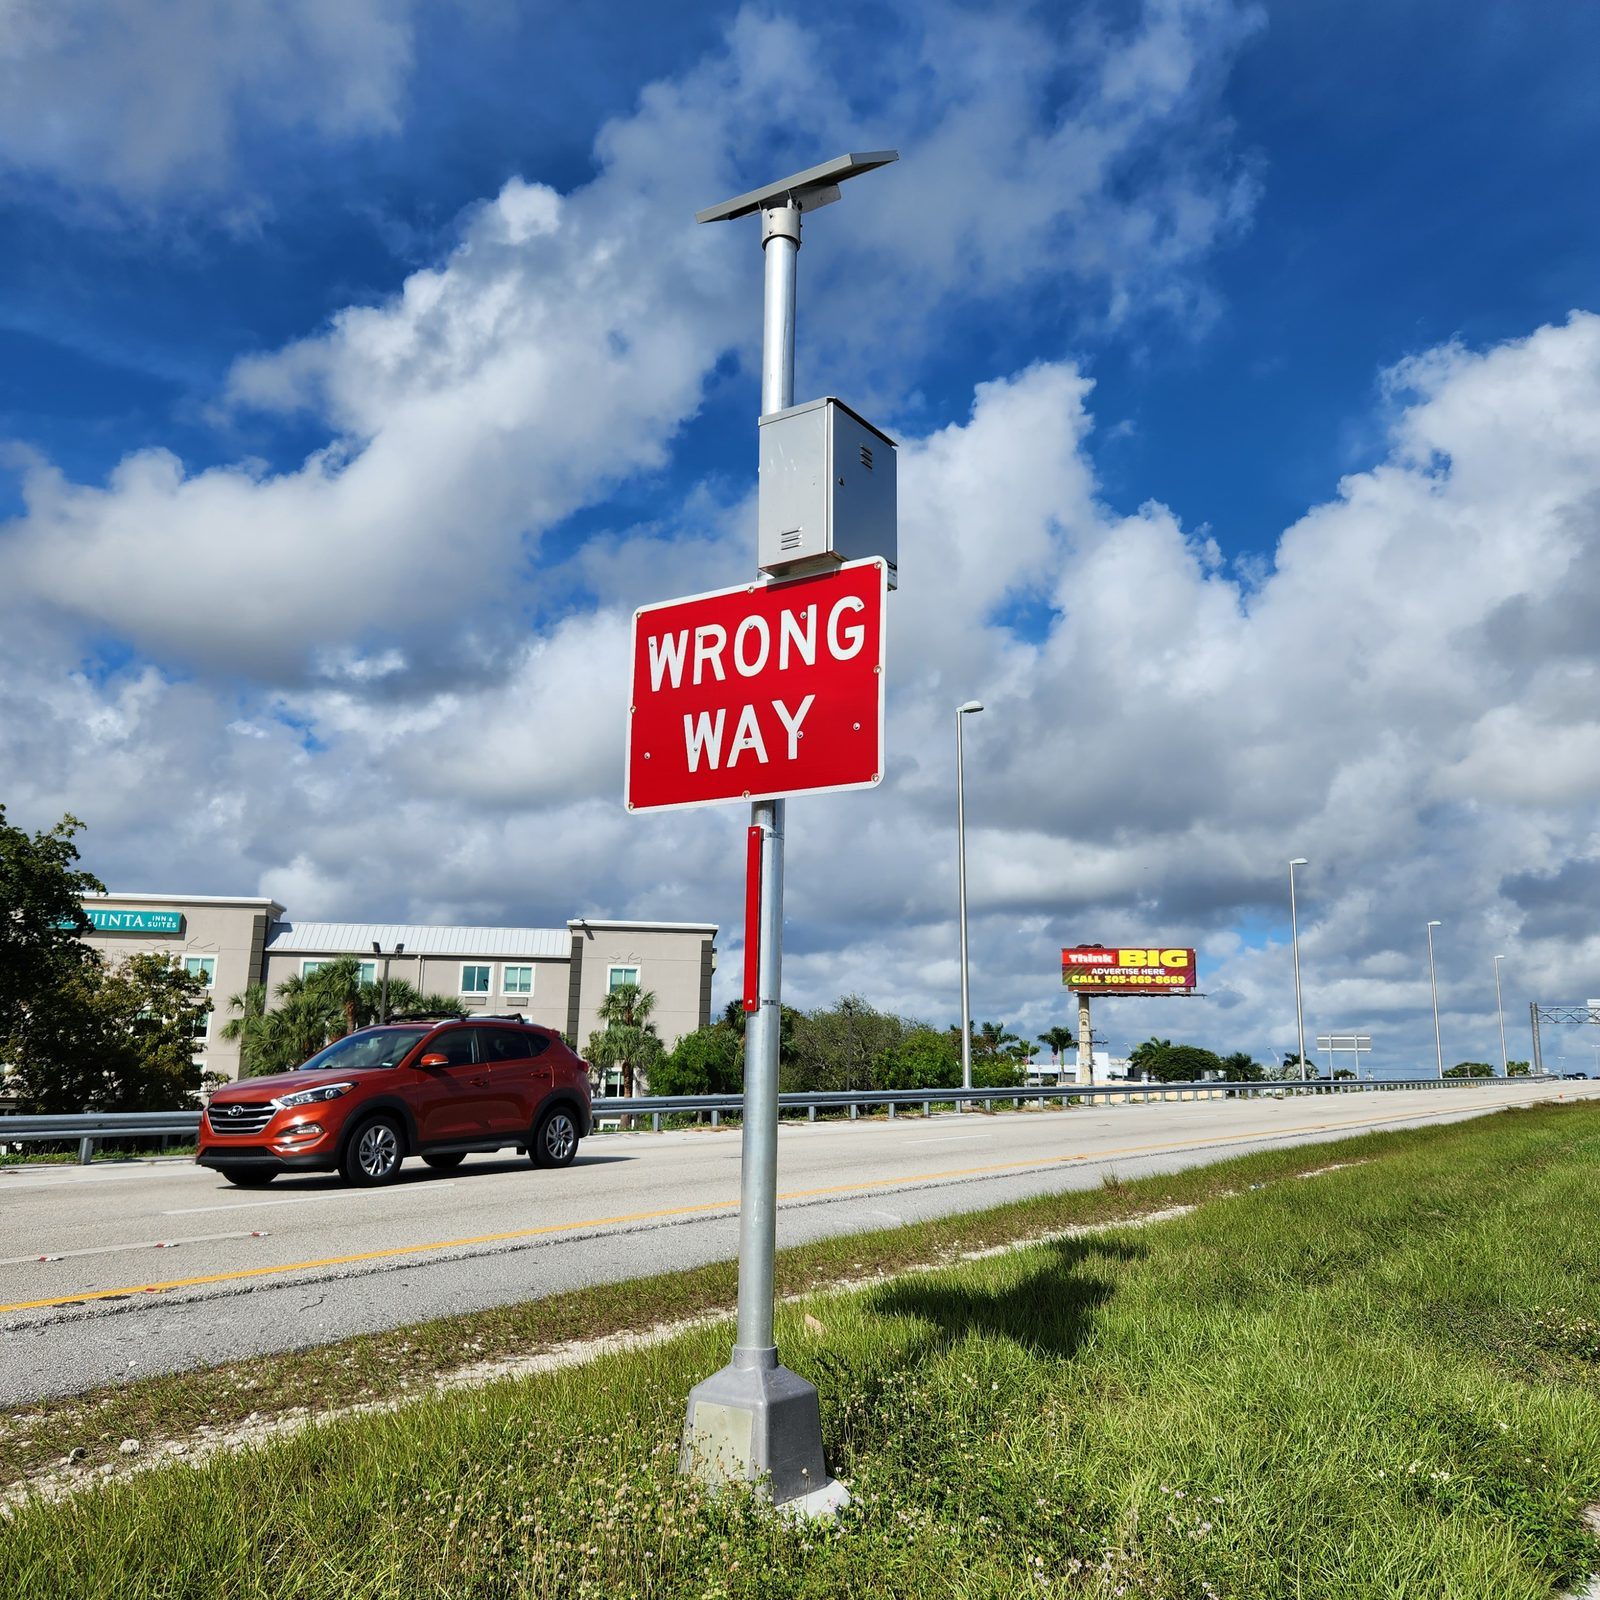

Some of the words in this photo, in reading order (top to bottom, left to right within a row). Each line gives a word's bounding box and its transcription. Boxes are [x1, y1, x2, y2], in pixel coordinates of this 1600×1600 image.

[647, 595, 866, 692] WRONG
[683, 694, 816, 773] WAY
[84, 913, 145, 927] UINTA
[1068, 953, 1113, 963] Think
[1118, 949, 1188, 967] BIG
[1091, 967, 1139, 975] ADVERTISE
[1140, 967, 1165, 975] HERE
[1071, 975, 1101, 984] CALL
